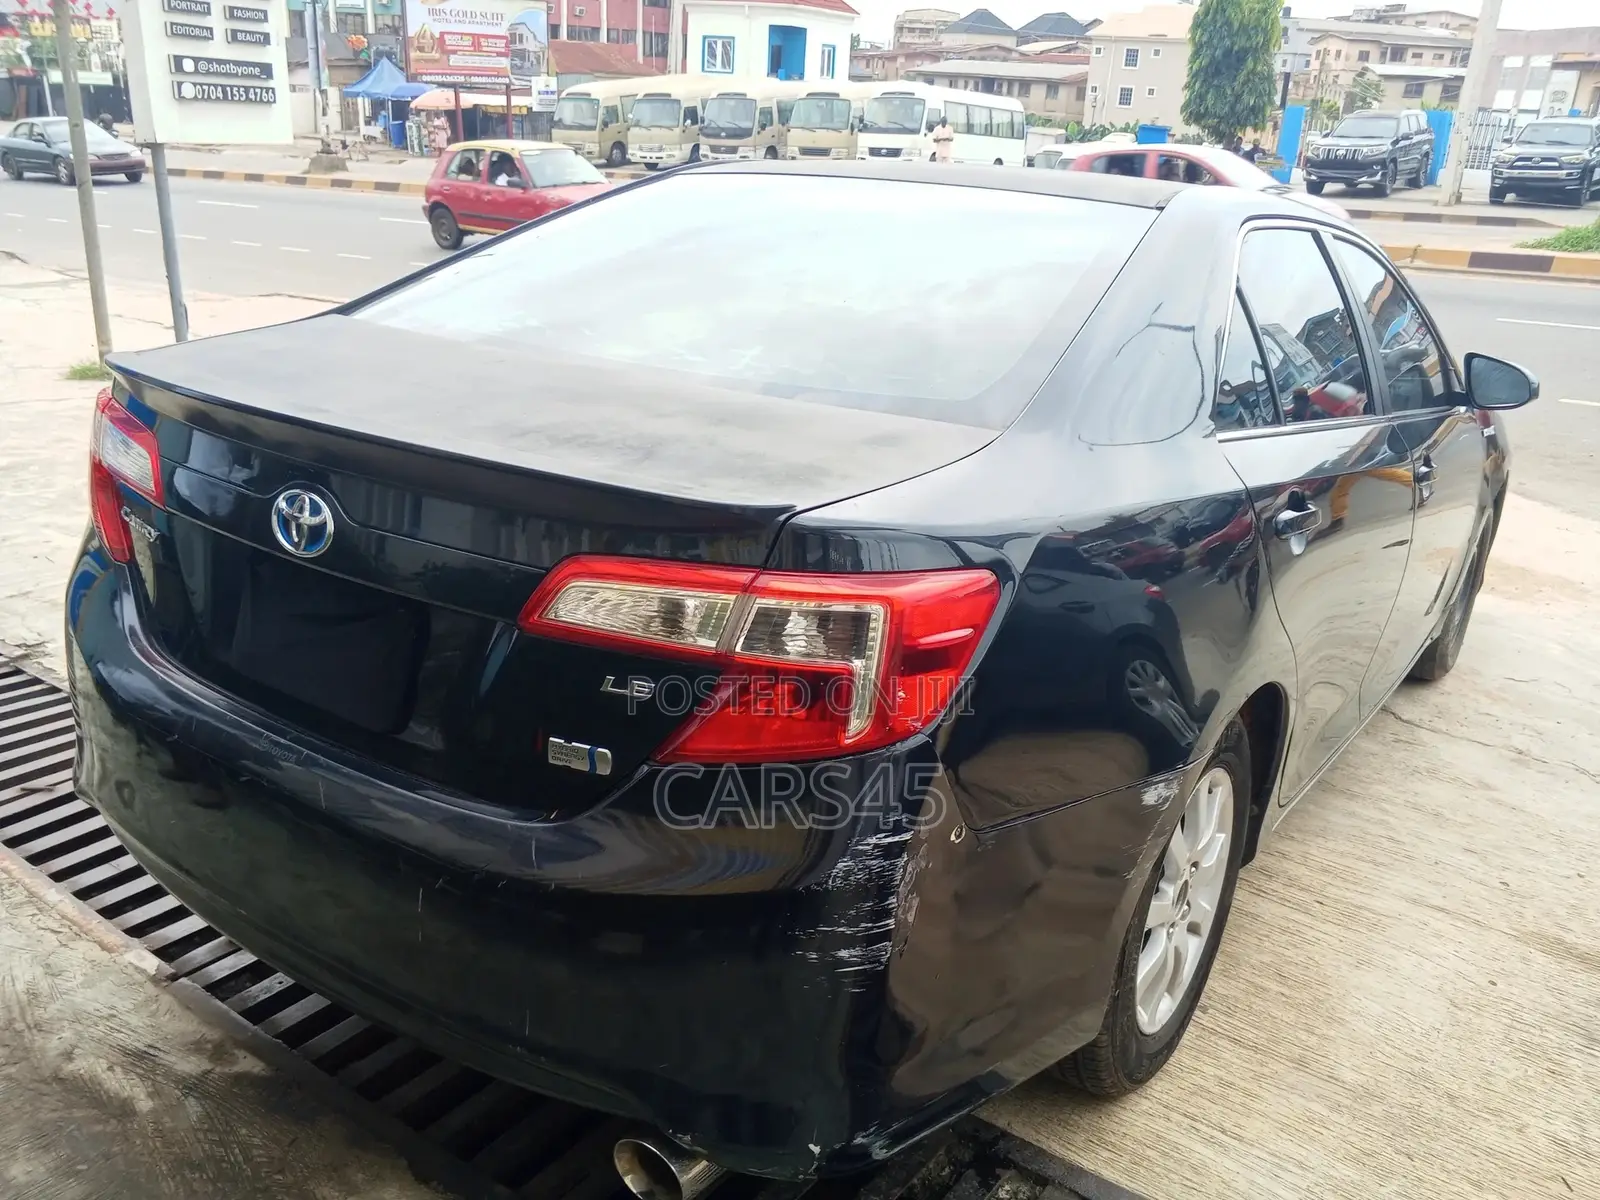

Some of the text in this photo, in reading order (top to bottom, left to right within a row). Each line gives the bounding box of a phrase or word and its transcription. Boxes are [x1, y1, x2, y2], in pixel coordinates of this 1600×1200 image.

[170, 0, 208, 13] PORTRAIT
[233, 9, 265, 20] FASHION
[427, 7, 505, 22] IRIS GOLD SUITE
[468, 19, 502, 27] APARTMENT
[172, 25, 213, 38] EDITORIAL
[237, 31, 265, 43] BEAUTY
[197, 60, 267, 79] @shotbyone_
[195, 86, 275, 103] 0704 155 4766
[600, 675, 655, 698] LE
